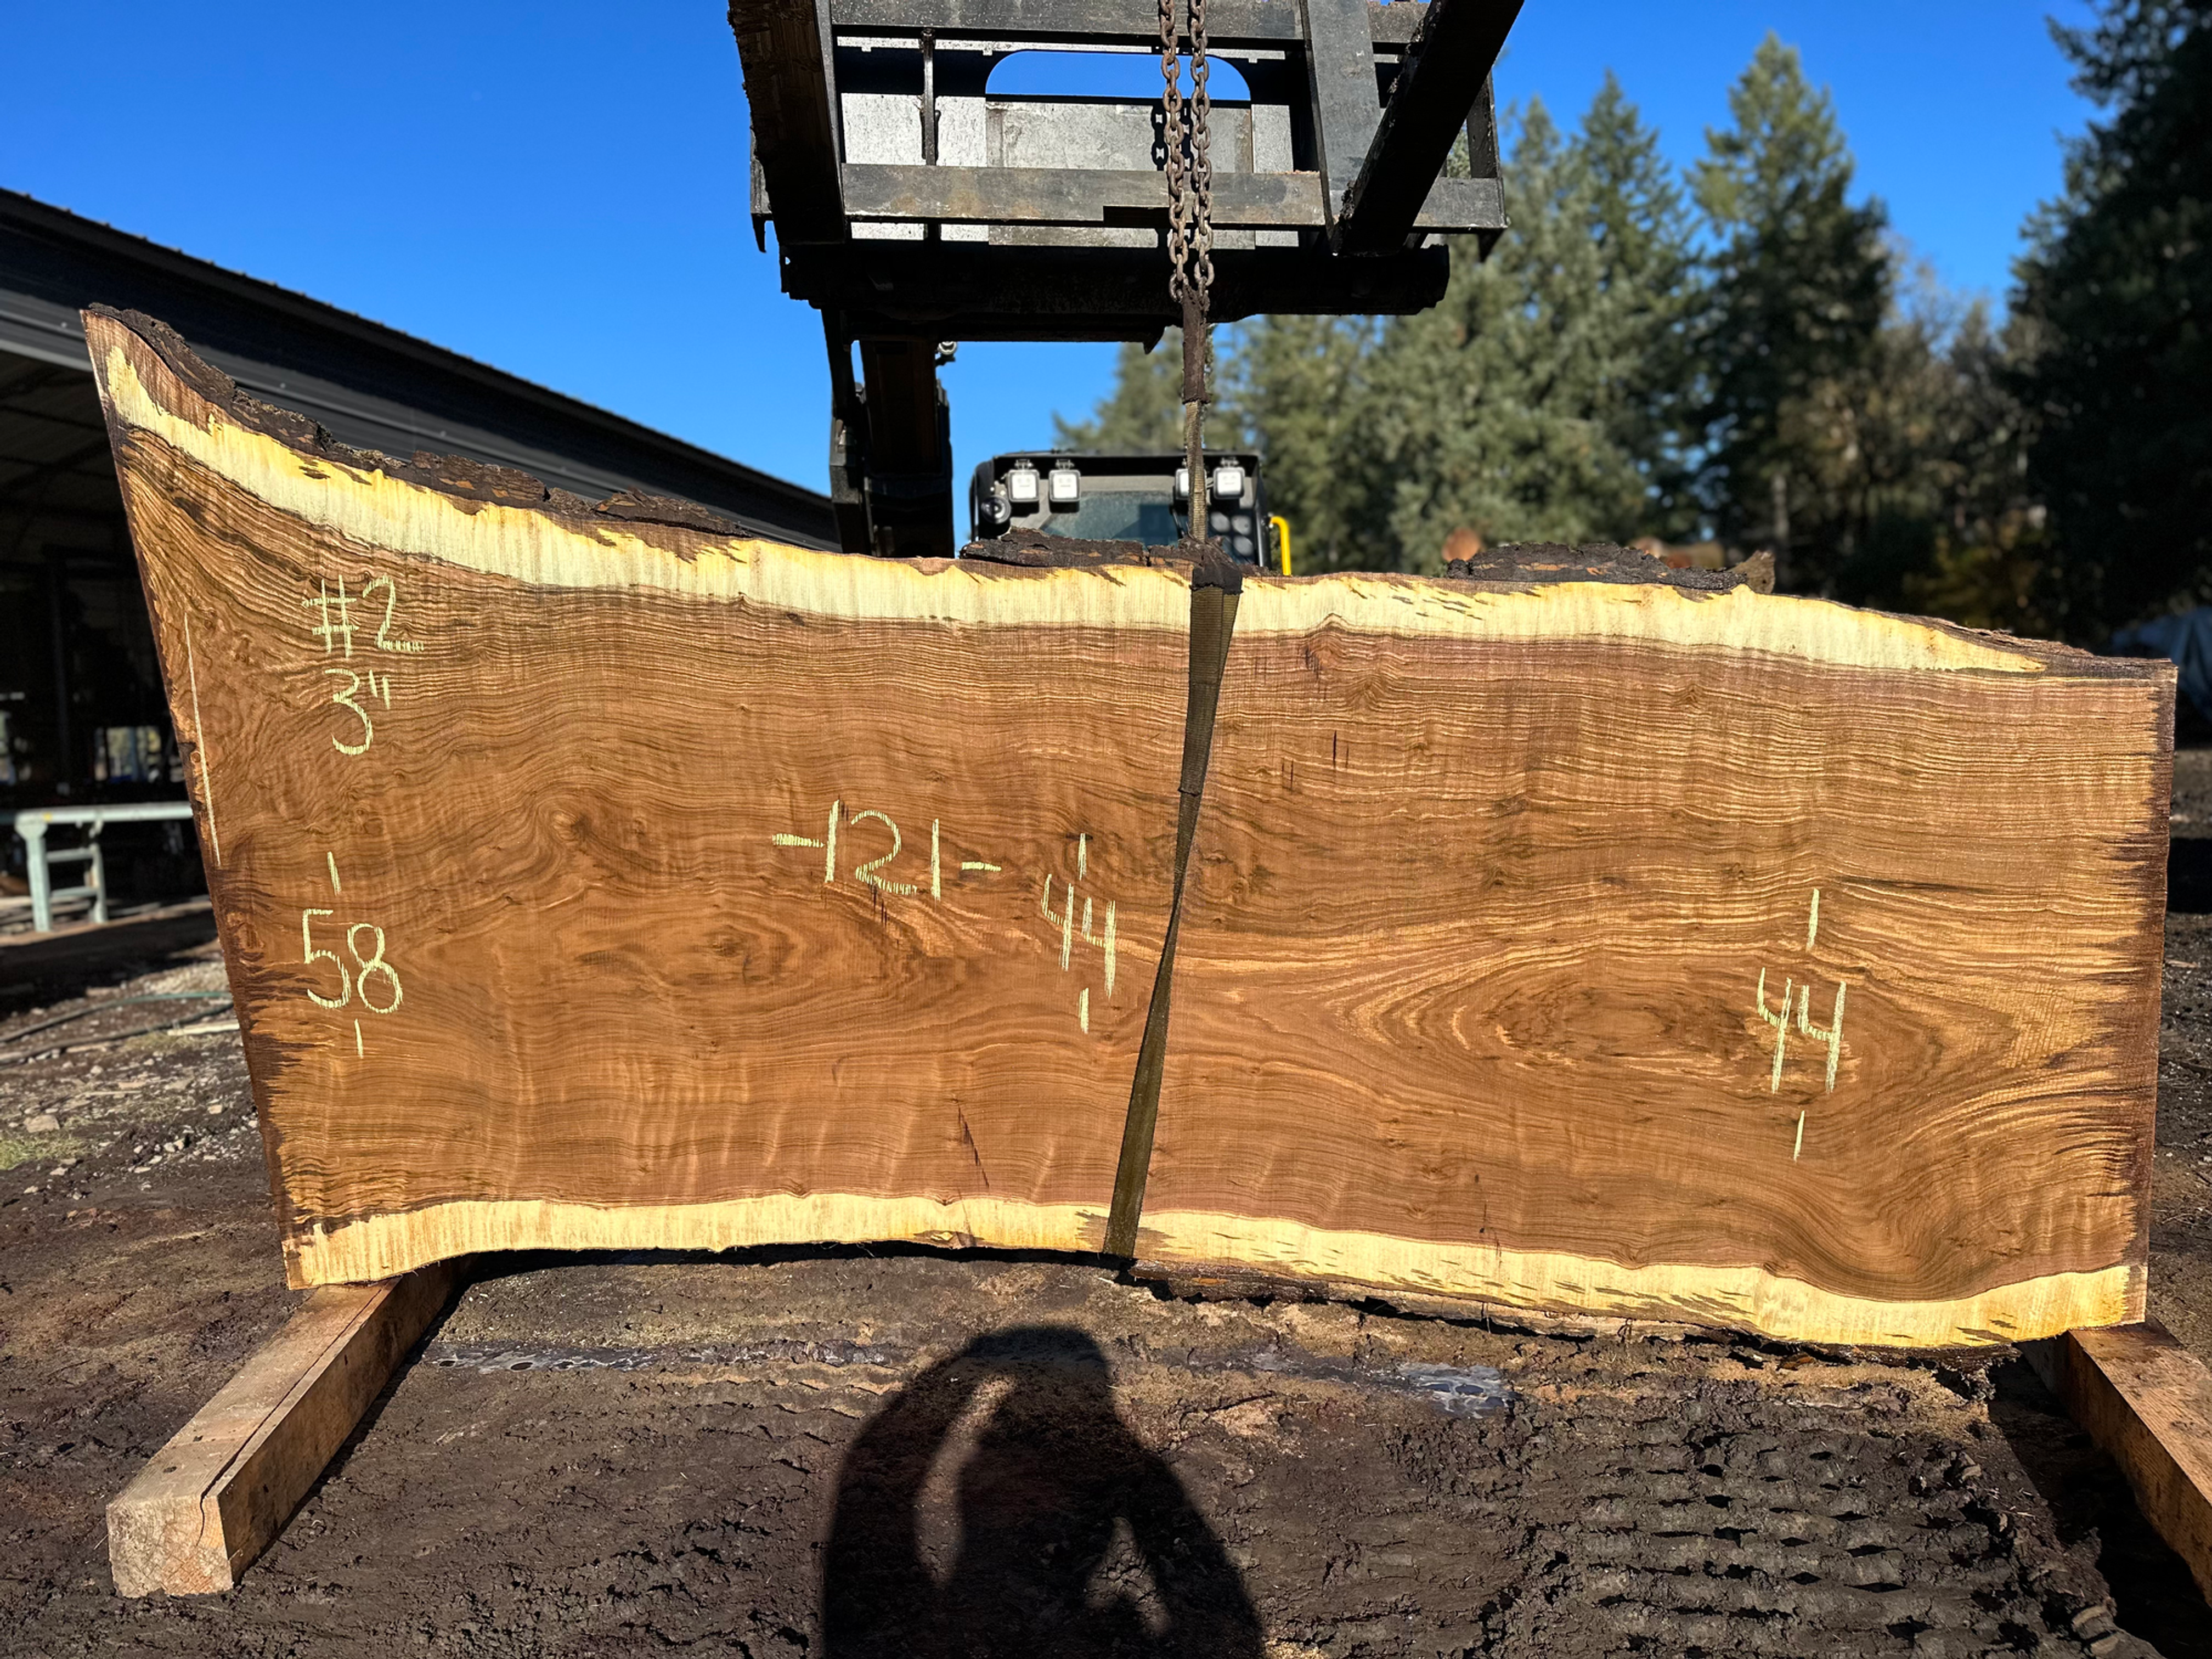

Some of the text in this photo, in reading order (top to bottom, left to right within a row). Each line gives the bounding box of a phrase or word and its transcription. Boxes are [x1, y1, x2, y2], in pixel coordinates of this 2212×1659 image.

[302, 574, 424, 658] #2
[325, 668, 391, 755] 3"
[302, 908, 403, 1014] 58
[1042, 873, 1116, 998] 44
[1757, 967, 1847, 1094] 44
